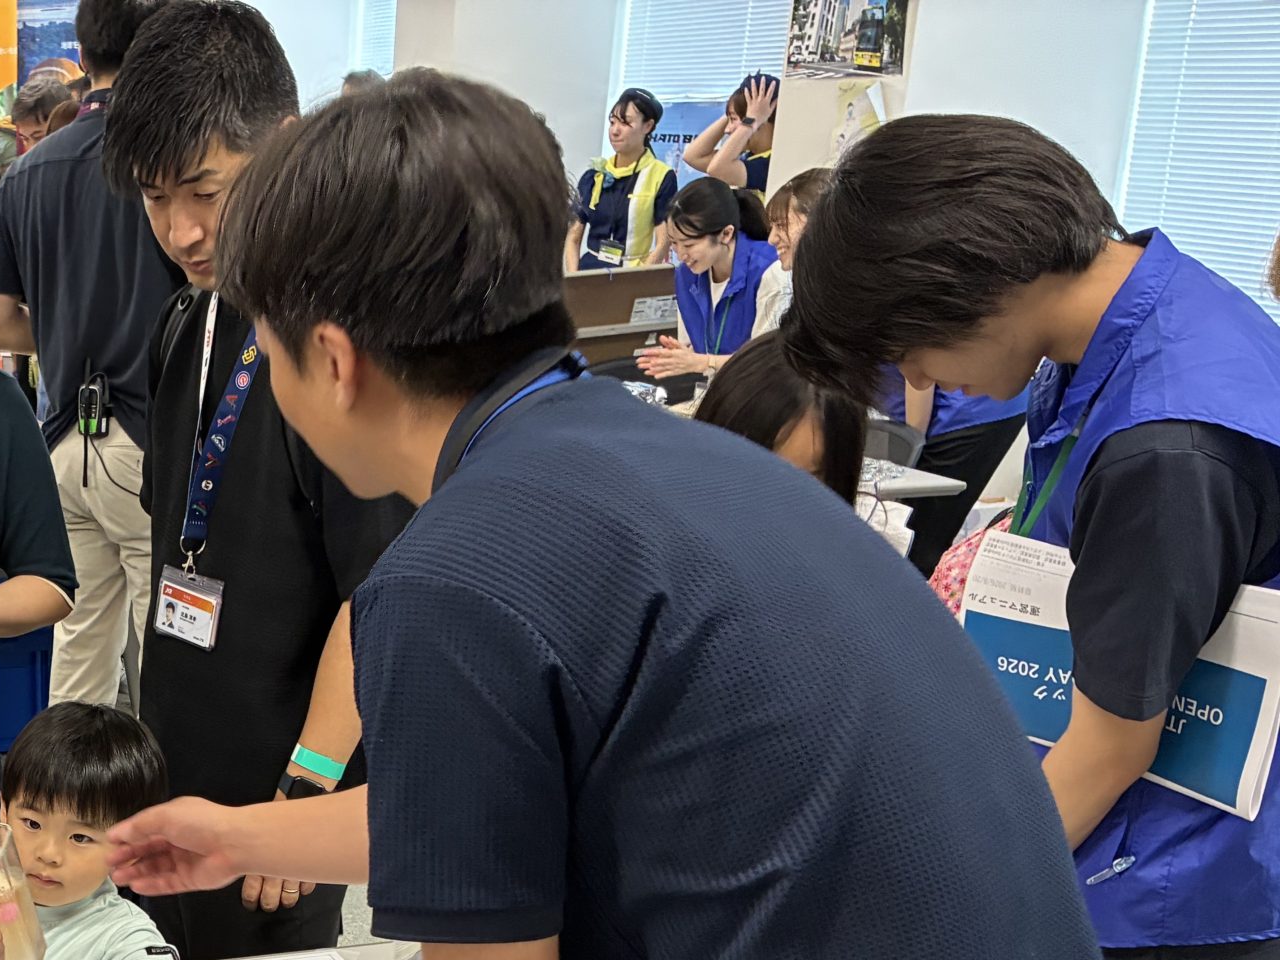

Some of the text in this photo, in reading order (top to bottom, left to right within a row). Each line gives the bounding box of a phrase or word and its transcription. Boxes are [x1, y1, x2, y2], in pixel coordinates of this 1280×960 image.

[682, 133, 698, 143] B
[968, 593, 1041, 617] 運営マニュアル
[997, 656, 1040, 679] 2026
[1172, 694, 1224, 726] OPEN
[1165, 715, 1187, 735] JT
